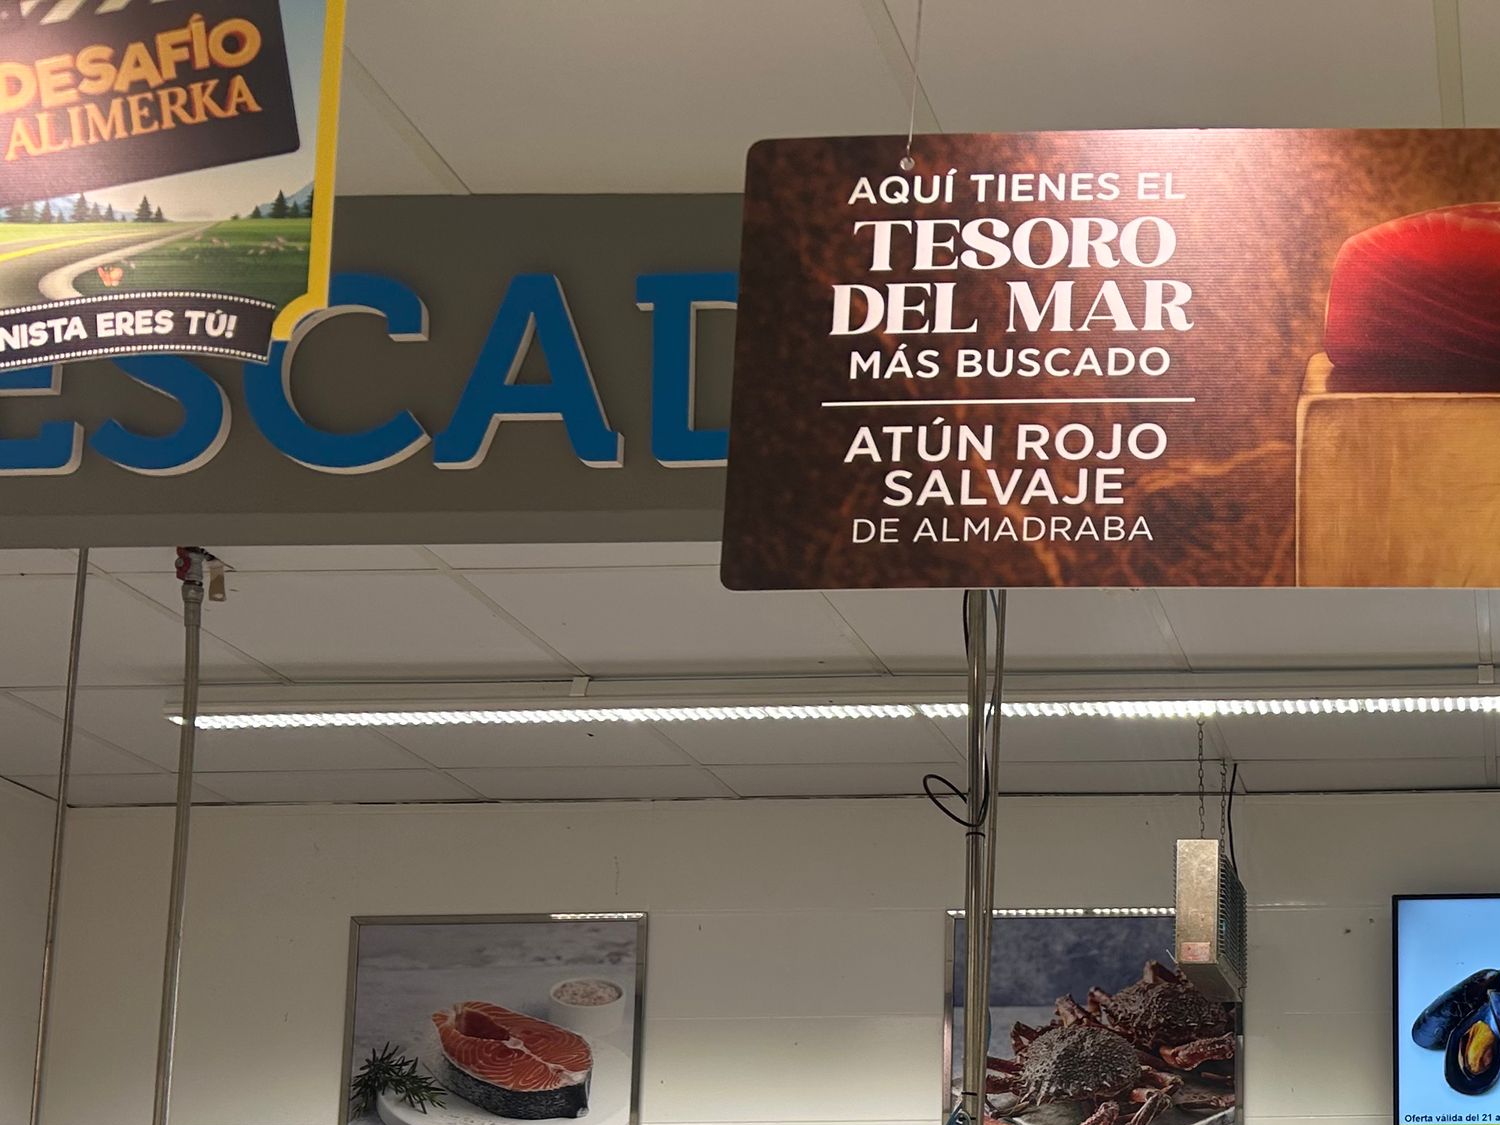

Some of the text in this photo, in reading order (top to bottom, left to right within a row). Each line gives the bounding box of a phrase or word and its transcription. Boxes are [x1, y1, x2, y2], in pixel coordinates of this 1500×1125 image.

[0, 13, 261, 113] DESAFÍO
[4, 74, 262, 161] ALIMERKA
[848, 168, 1187, 204] AQUÍ TIENES EL
[853, 215, 1177, 272] TESORO
[96, 309, 174, 338] ERES
[184, 308, 237, 339] TÚ!
[829, 279, 1195, 336] DEL MAR
[849, 344, 1171, 380] MÁS BUSCADO
[843, 416, 1168, 463] ATÚN ROJO
[882, 467, 1125, 507] SALVAJE
[852, 516, 1154, 543] DE ALMADRABA
[1404, 1114, 1433, 1123] Oferta
[1435, 1113, 1463, 1123] válida
[1465, 1113, 1480, 1122] del
[1482, 1113, 1493, 1122] 21
